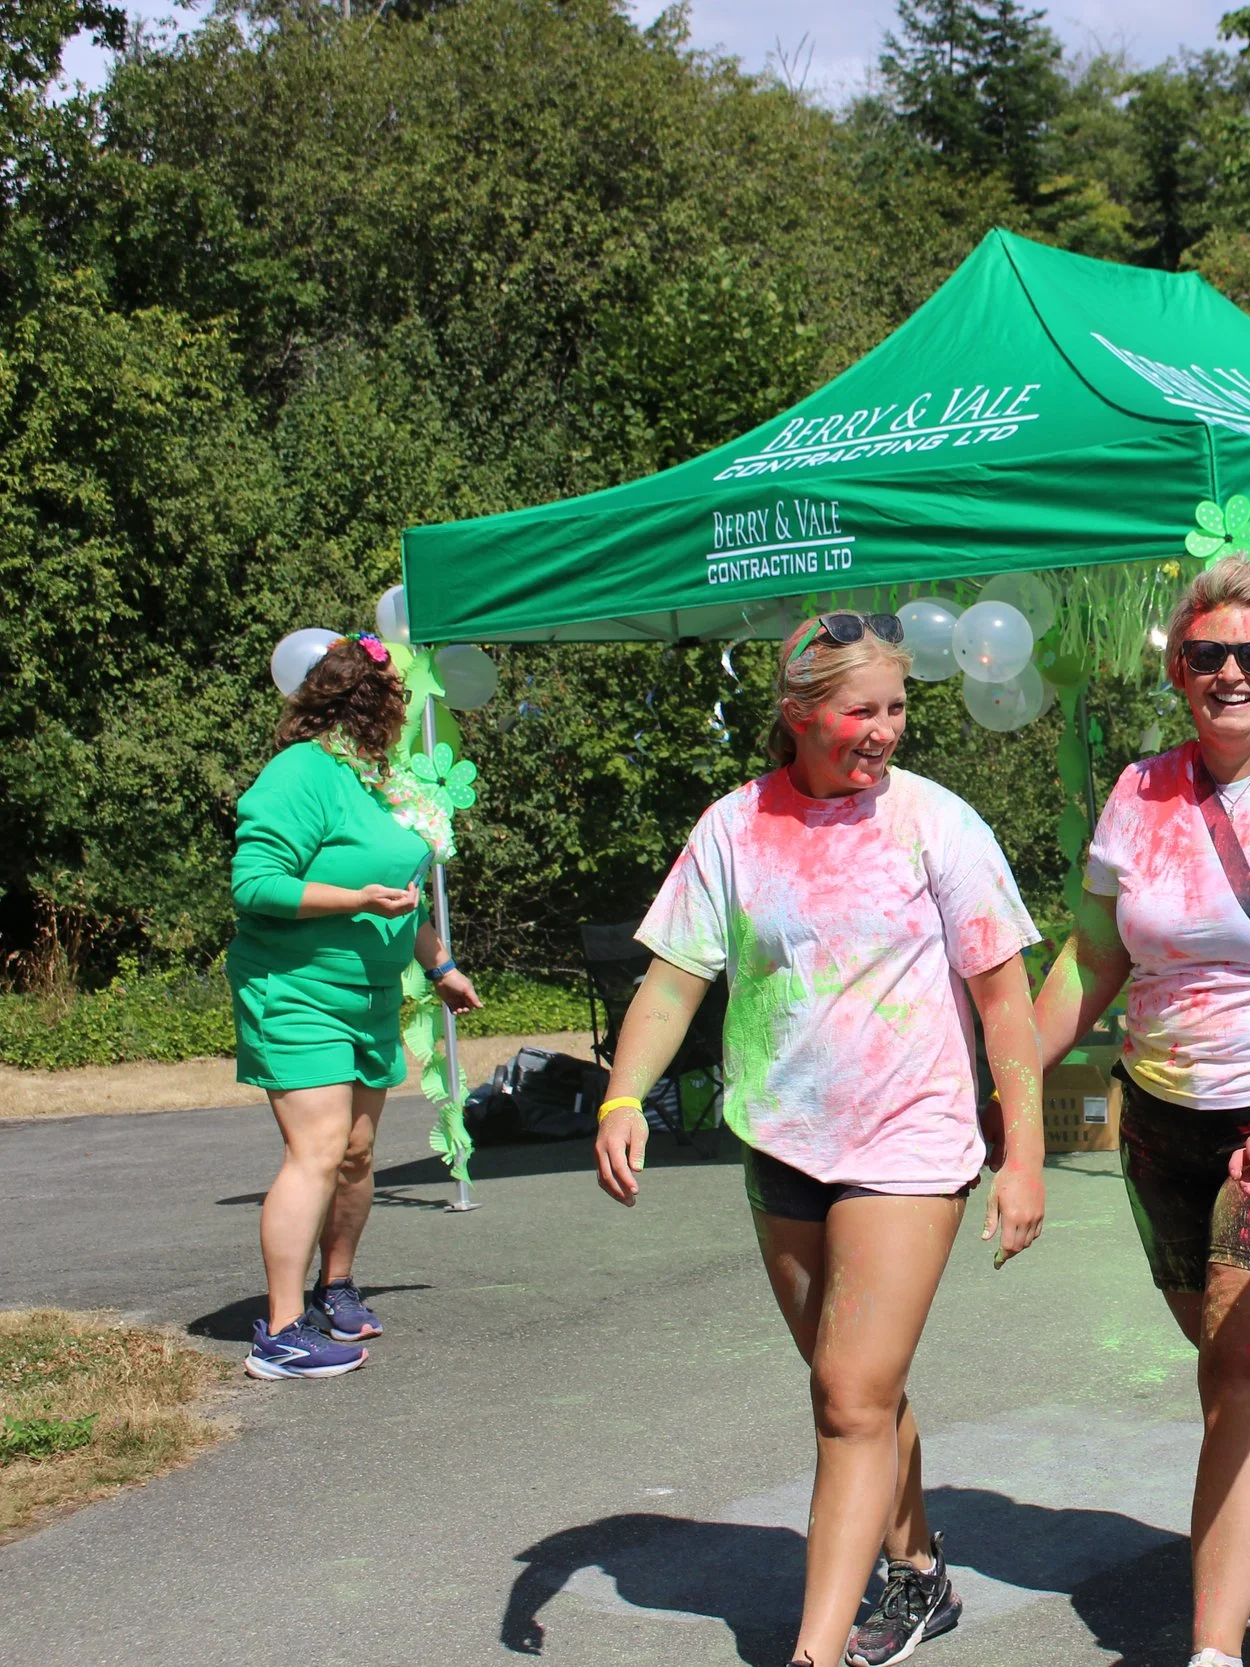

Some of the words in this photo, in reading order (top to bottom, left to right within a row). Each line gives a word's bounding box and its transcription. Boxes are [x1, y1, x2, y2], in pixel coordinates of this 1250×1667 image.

[761, 404, 898, 452] BERRY
[889, 392, 932, 432] &
[940, 384, 1041, 424] VALE
[713, 433, 950, 481] CONTRACTING
[952, 424, 1019, 446] LTD
[713, 508, 769, 549] BERRY
[775, 500, 792, 540] &
[793, 498, 842, 537] VALE
[707, 552, 818, 585] CONTRACTING
[824, 548, 852, 571] LTD
